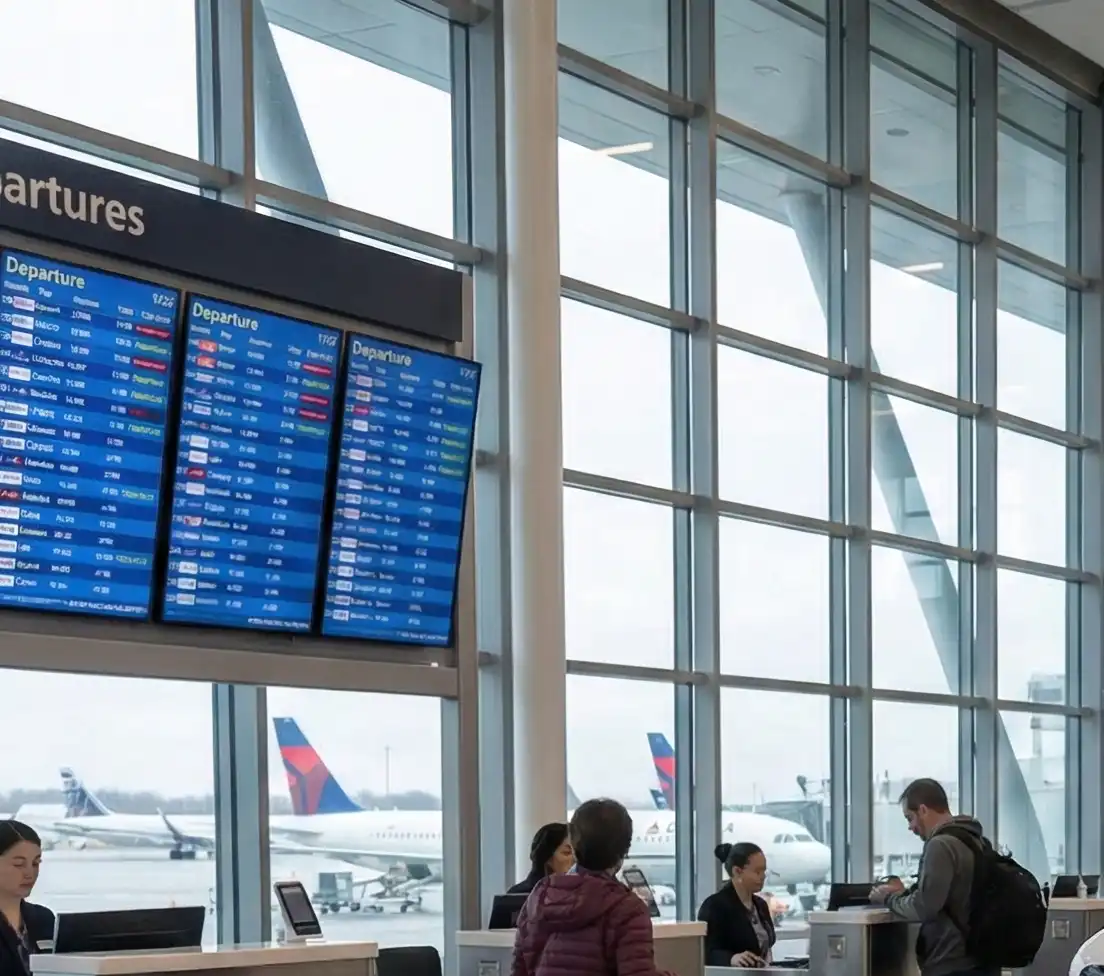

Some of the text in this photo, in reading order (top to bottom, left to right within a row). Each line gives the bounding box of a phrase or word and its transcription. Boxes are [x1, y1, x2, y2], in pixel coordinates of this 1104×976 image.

[0, 172, 145, 236] artures
[6, 256, 86, 289] Departure
[192, 302, 259, 331] Departure
[353, 341, 412, 367] Departure
